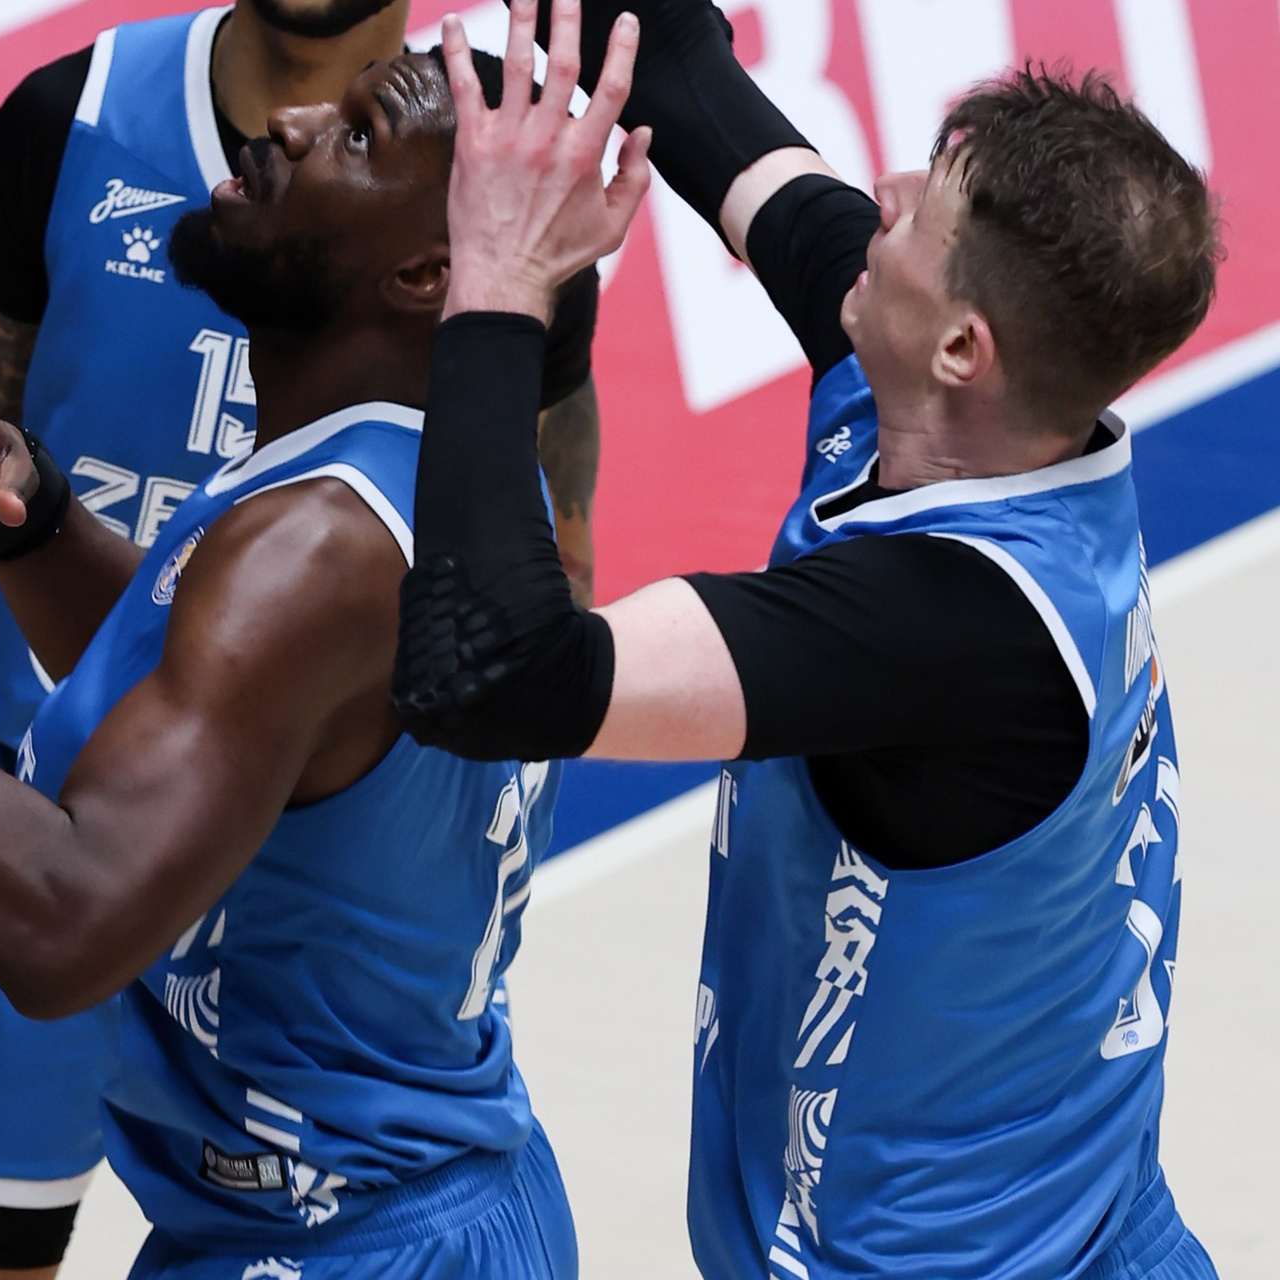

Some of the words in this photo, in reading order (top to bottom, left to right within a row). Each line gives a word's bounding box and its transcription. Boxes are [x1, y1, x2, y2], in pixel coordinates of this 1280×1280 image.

[105, 259, 167, 284] KELME
[187, 327, 258, 460] 15
[259, 1161, 280, 1182] 3XL
